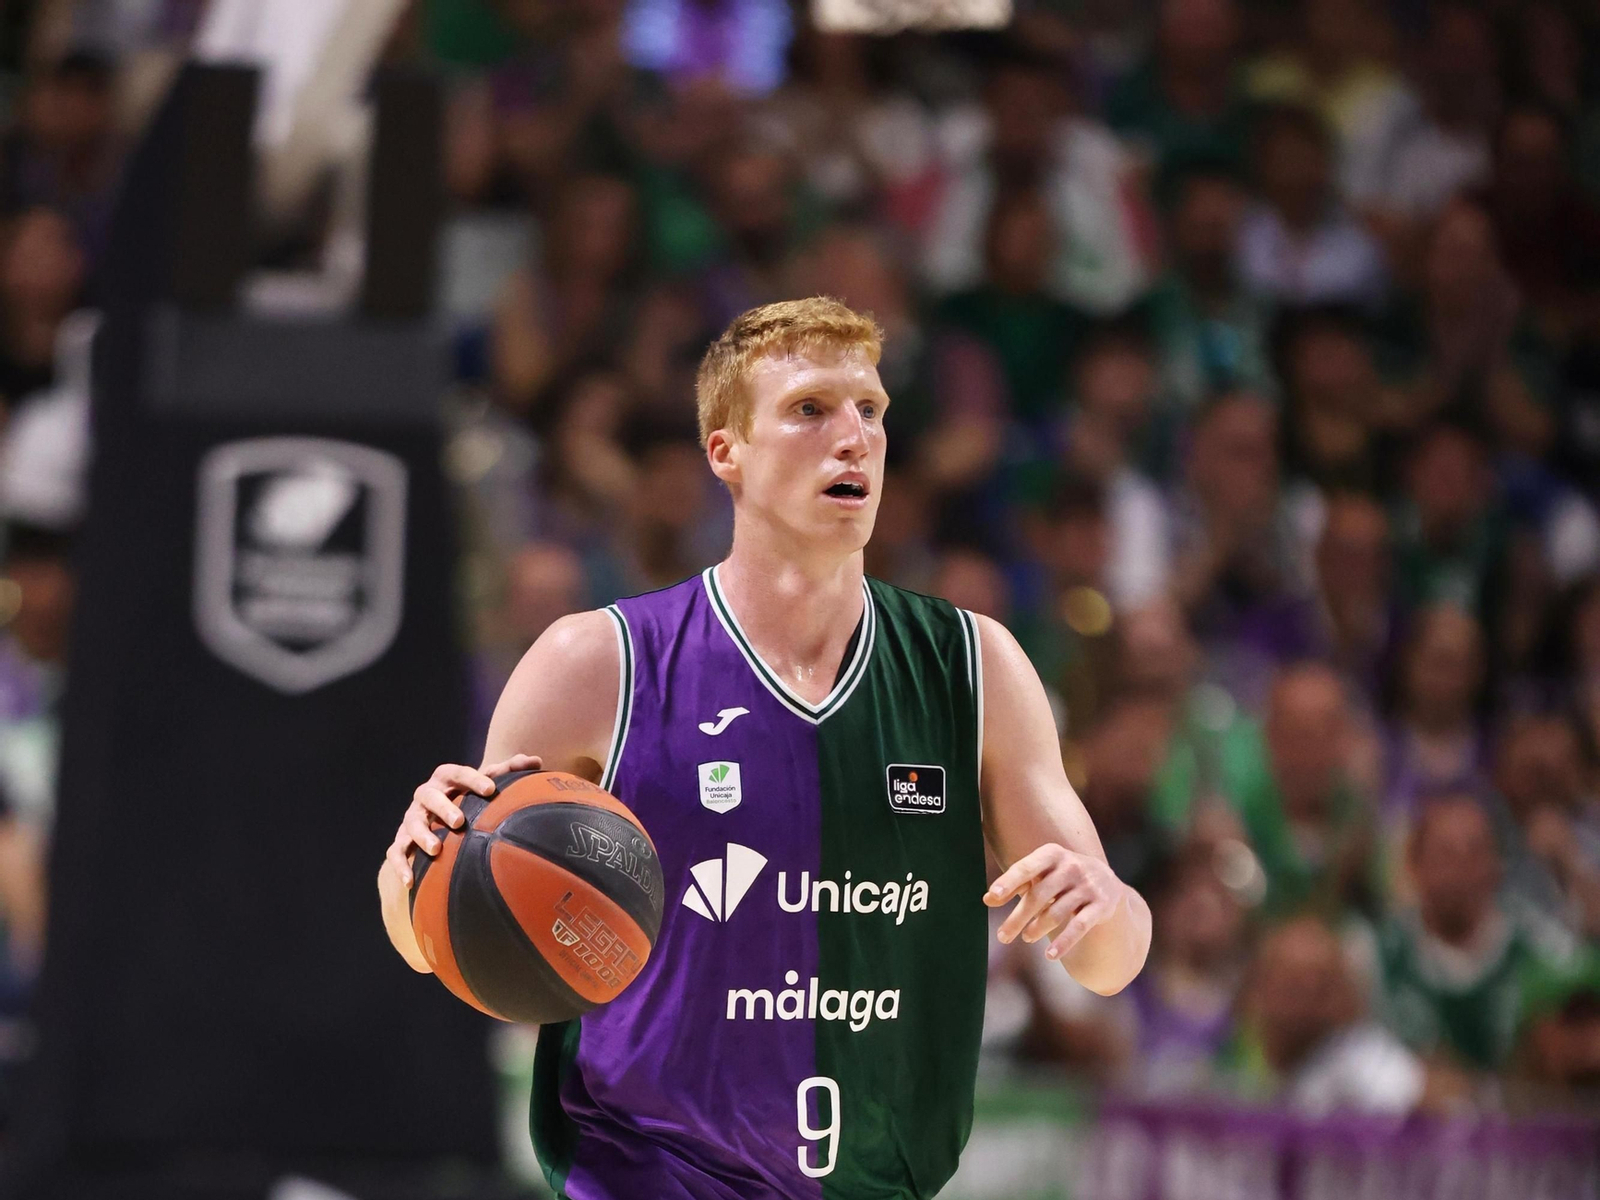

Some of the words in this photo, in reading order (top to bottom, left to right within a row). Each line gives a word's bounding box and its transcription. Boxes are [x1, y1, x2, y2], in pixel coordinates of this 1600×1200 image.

[893, 778, 917, 794] liga
[894, 792, 942, 806] endesa
[777, 870, 929, 926] Unicaja
[797, 1076, 840, 1178] 9
